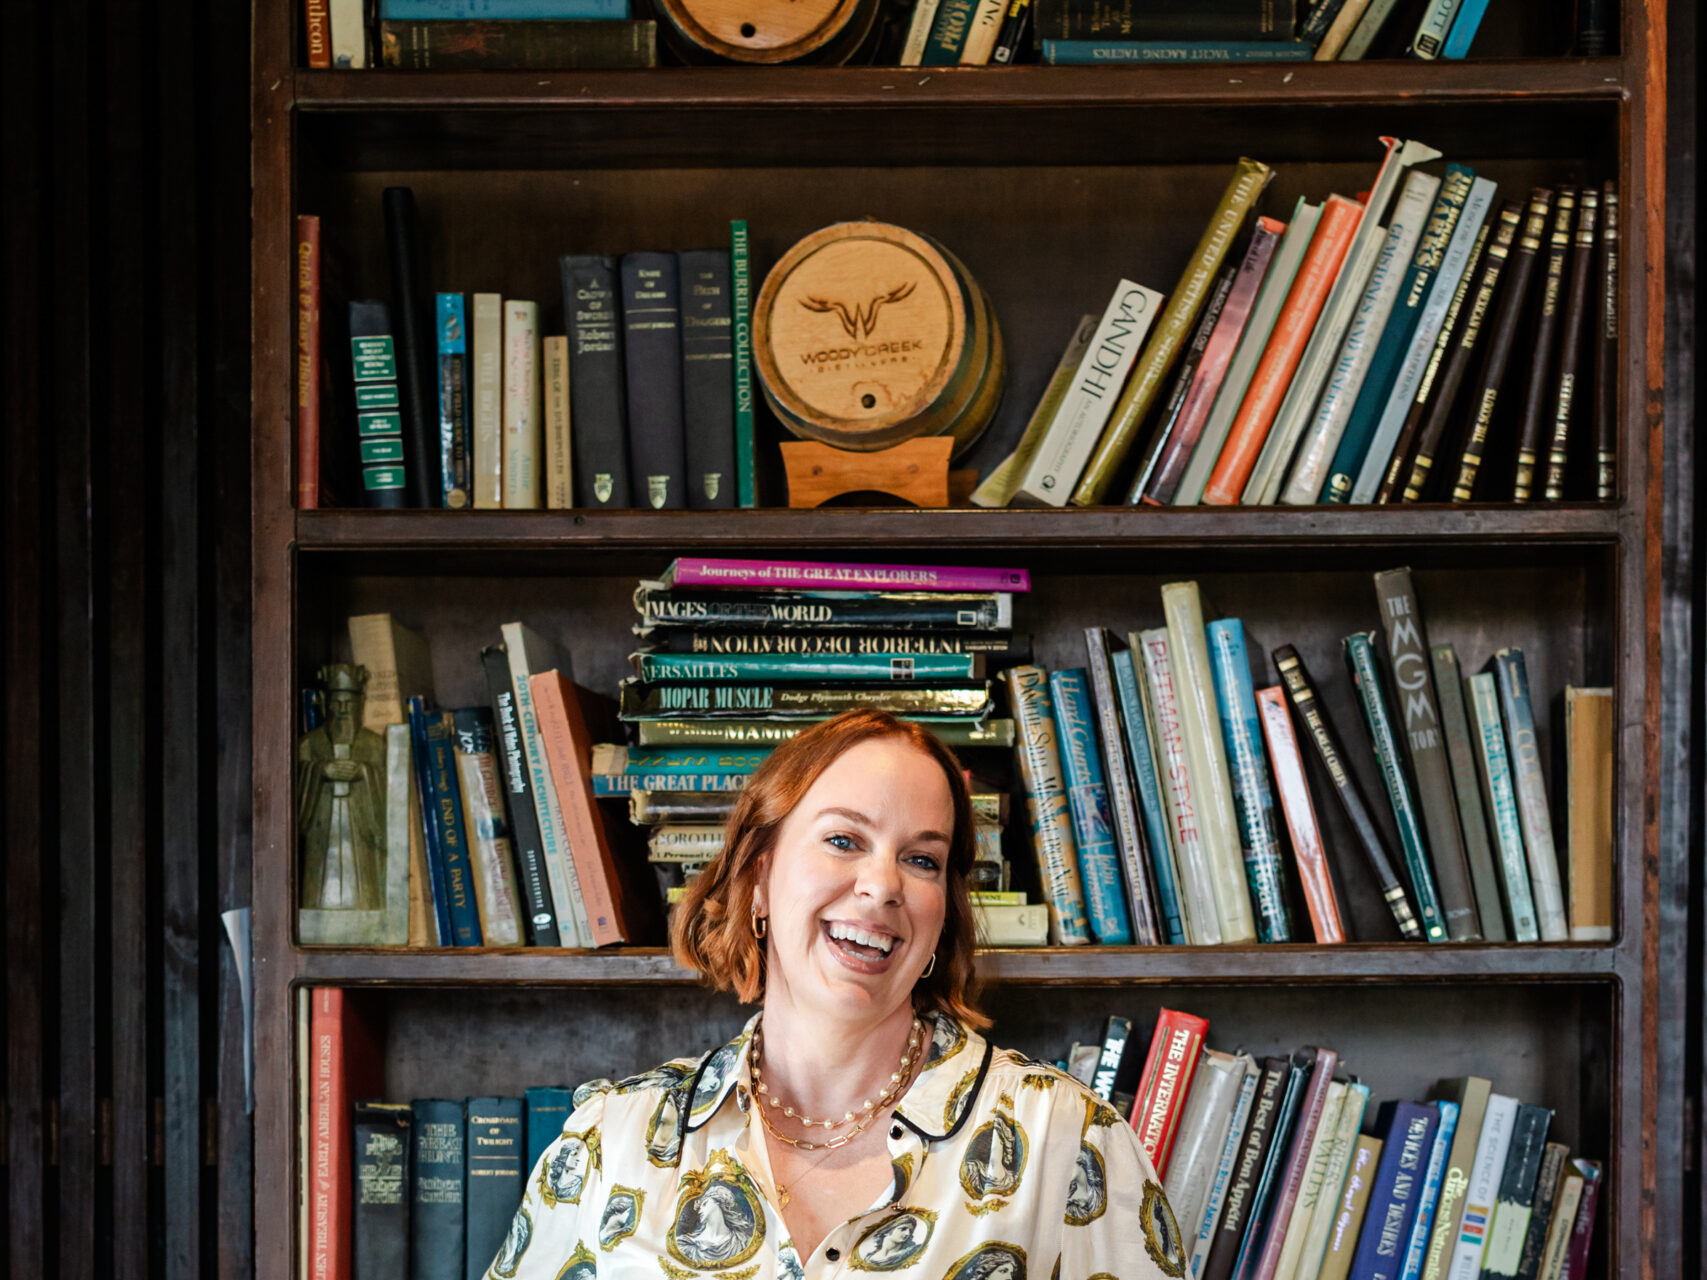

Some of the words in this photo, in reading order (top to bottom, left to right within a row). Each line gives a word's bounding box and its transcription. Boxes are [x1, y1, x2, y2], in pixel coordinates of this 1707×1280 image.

[1229, 172, 1254, 206] THE
[734, 228, 747, 259] THE
[1200, 206, 1237, 264] UNITED
[1359, 219, 1405, 313] GEMSTONES
[734, 261, 749, 319] BURRELL
[1405, 269, 1430, 309] ELLIS
[1078, 286, 1150, 402] GANDHI
[1344, 315, 1368, 352] AND
[735, 321, 752, 413] COLLECTION
[800, 347, 862, 366] WOODY
[698, 563, 756, 579] Journeys
[758, 565, 771, 577] of
[772, 565, 801, 578] THE
[803, 566, 851, 580] GREAT
[644, 599, 706, 618] IMAGES
[771, 604, 832, 622] WORLD
[1387, 594, 1411, 618] THE
[709, 636, 851, 653] DECORATION
[857, 636, 961, 653] INTERIOR
[496, 691, 511, 707] The
[659, 687, 709, 709] MOPAR
[713, 687, 773, 709] MUSCLE
[779, 692, 807, 702] Dodge
[1058, 672, 1086, 726] Hard
[1304, 706, 1322, 729] THE
[1068, 723, 1097, 785] Courts
[1141, 638, 1189, 757] PUTMAN
[1166, 762, 1203, 845] STYLE
[1312, 725, 1335, 758] GREAT
[514, 673, 544, 765] 20TH-CENTURY
[530, 765, 559, 855] ARCHITECTURE
[605, 774, 640, 791] THE
[642, 774, 697, 791] GREAT
[439, 796, 457, 826] END
[443, 827, 459, 848] OF
[447, 850, 460, 863] A
[447, 865, 469, 910] PARTY
[319, 1034, 331, 1078] HOUSES
[1099, 1035, 1125, 1069] THE
[1166, 1026, 1190, 1062] THE
[1261, 1068, 1283, 1099] The
[317, 1080, 331, 1139] AMERICAN
[1251, 1097, 1274, 1132] Best
[1488, 1110, 1505, 1139] THE
[1247, 1131, 1265, 1149] of
[1397, 1113, 1428, 1171] DEVICES
[318, 1140, 329, 1177] EARLY
[1237, 1145, 1260, 1180] Bon
[1477, 1140, 1498, 1187] SCIENCE
[1390, 1170, 1413, 1201] AND
[1453, 1176, 1468, 1198] The
[316, 1193, 328, 1250] TREASURY
[1374, 1198, 1407, 1258] DESIRES
